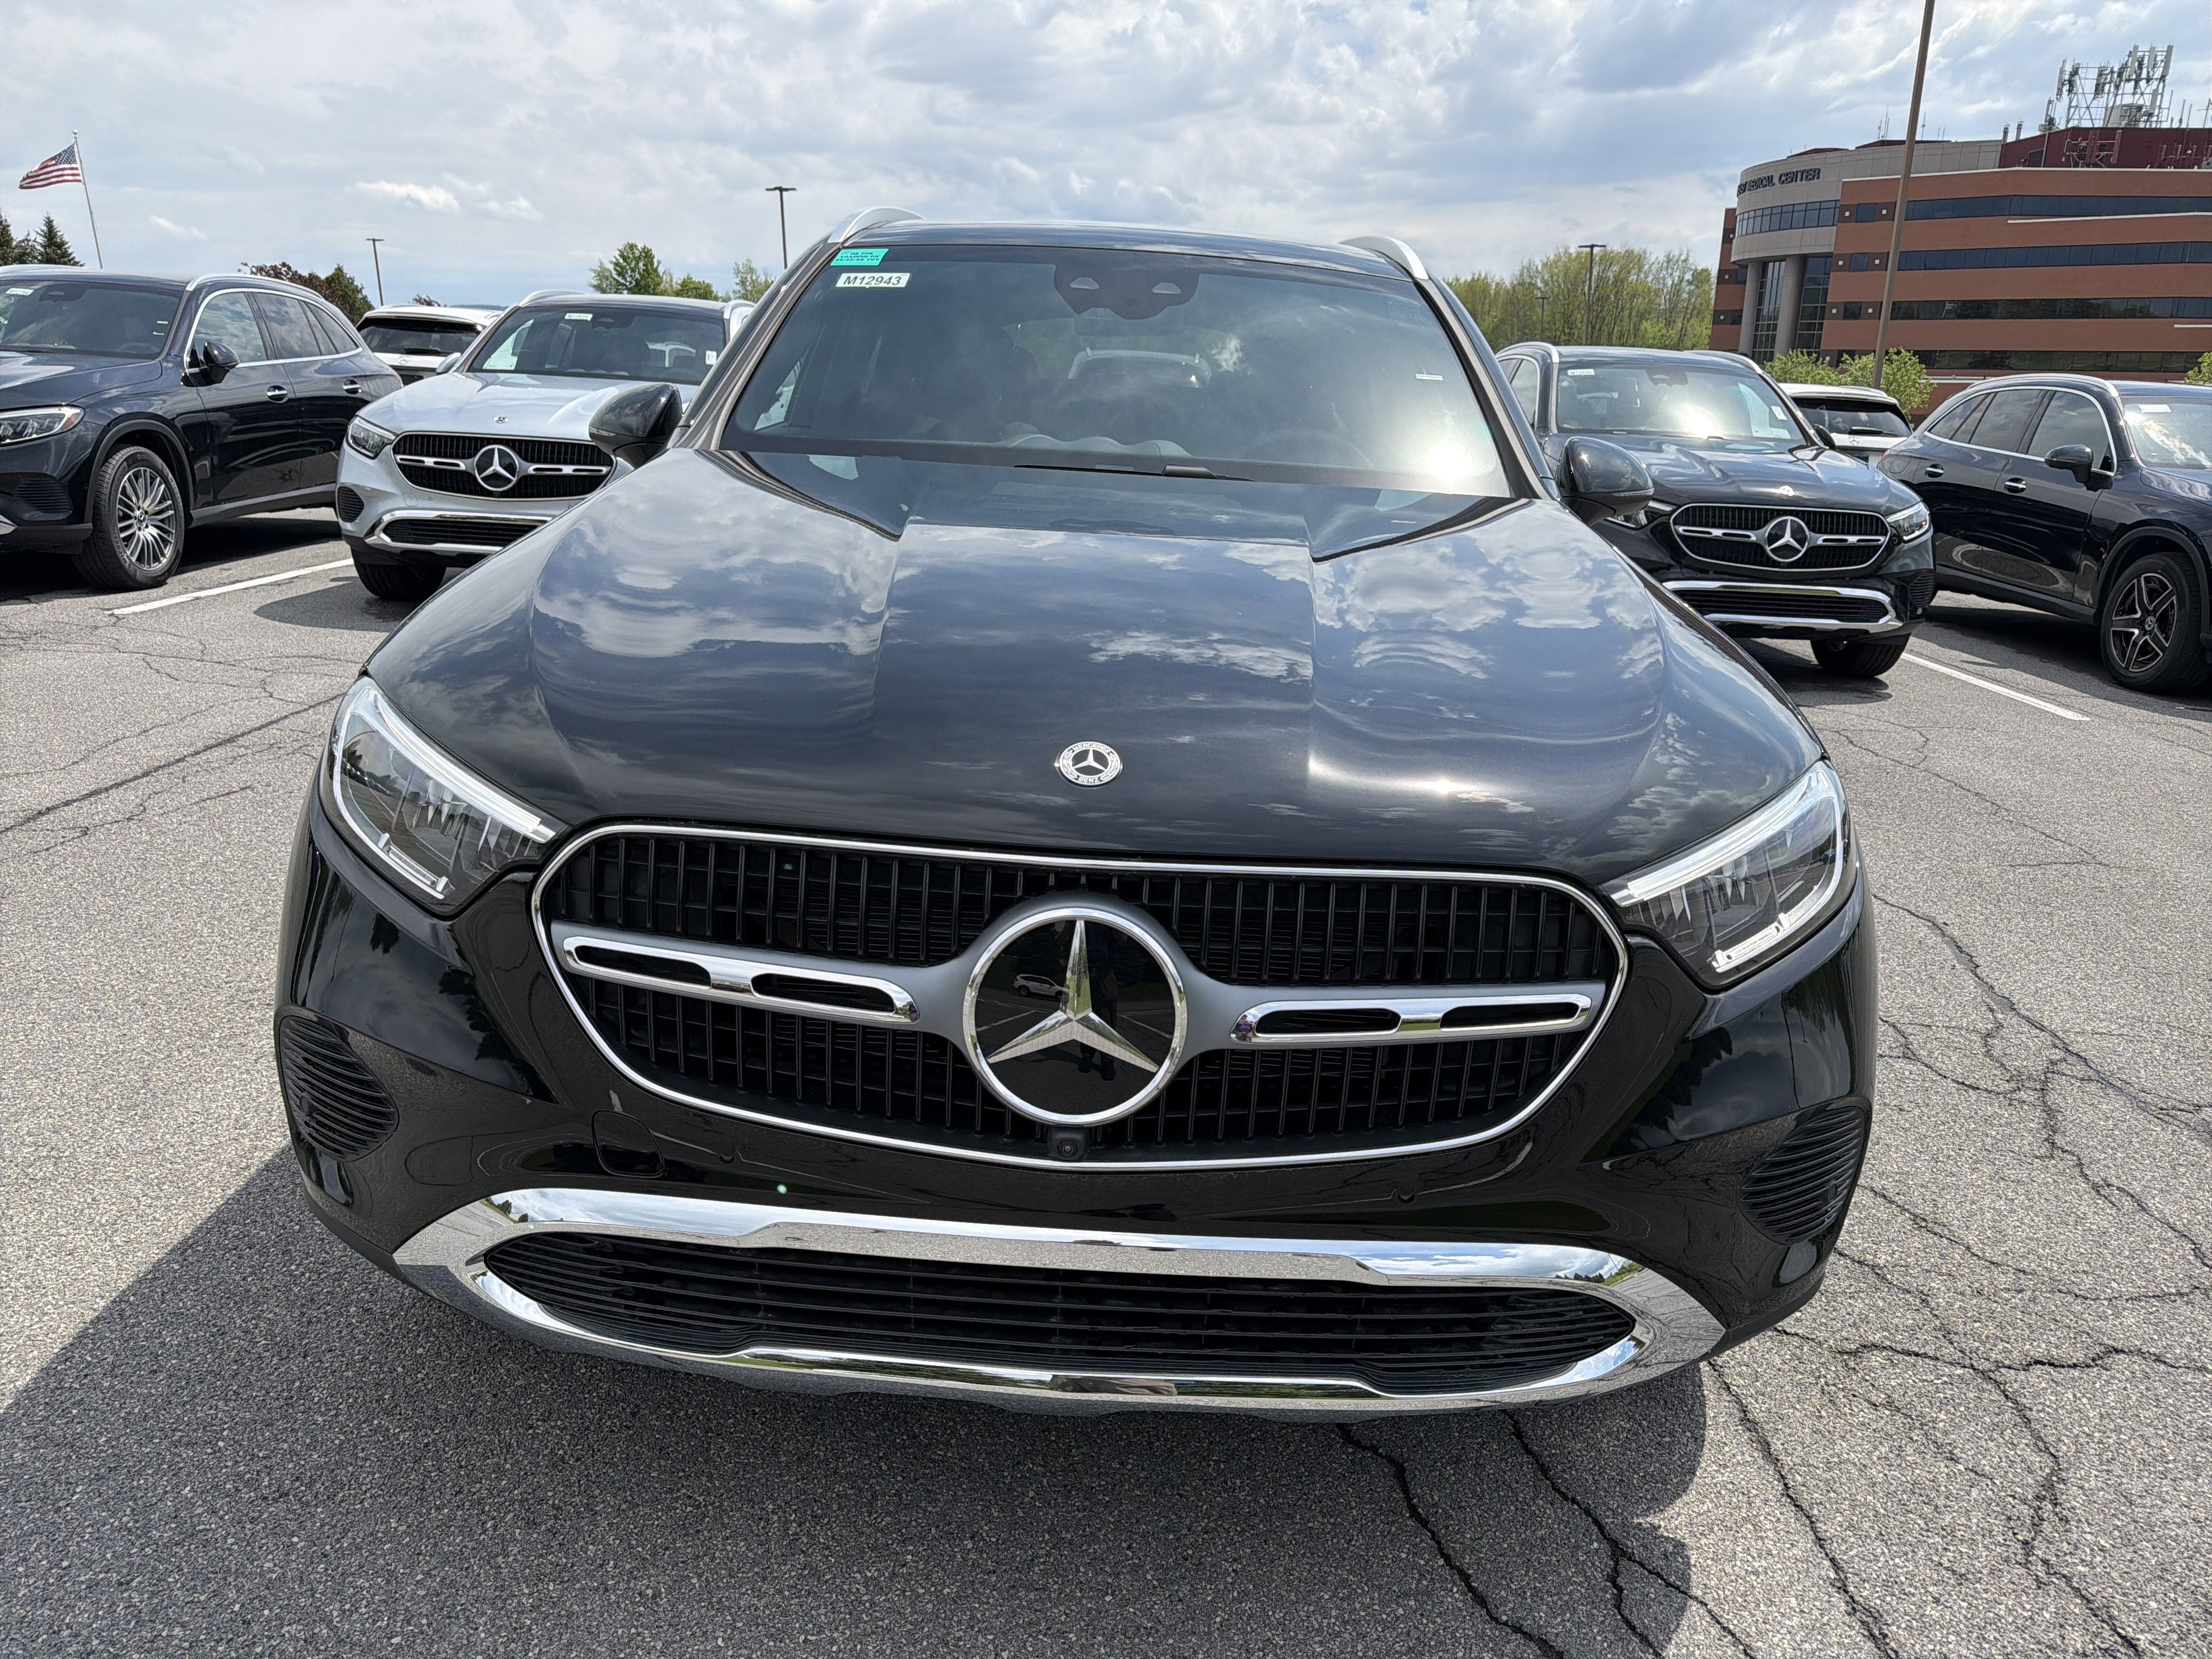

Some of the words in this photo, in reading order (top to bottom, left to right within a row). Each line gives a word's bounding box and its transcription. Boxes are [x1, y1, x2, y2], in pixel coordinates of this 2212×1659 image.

[1747, 174, 1775, 191] MEDICAL
[1778, 167, 1821, 185] CENTER
[843, 275, 902, 286] M12943
